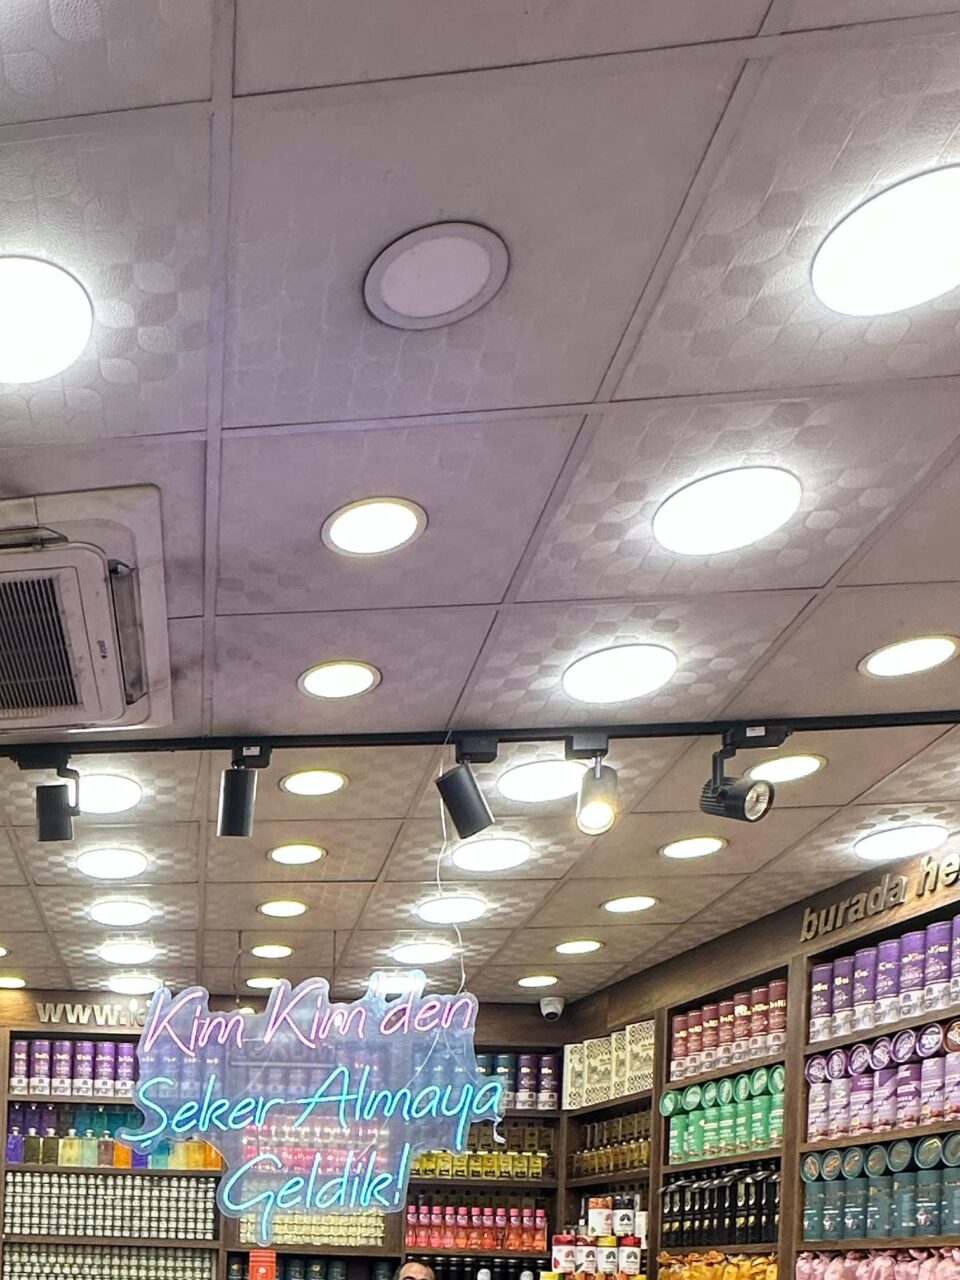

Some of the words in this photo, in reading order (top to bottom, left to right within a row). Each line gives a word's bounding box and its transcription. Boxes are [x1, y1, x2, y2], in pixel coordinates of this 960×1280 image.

[799, 874, 908, 943] burada
[143, 989, 244, 1057] Kim
[120, 1074, 285, 1148] Şeker
[293, 1065, 503, 1151] Almaya
[223, 1142, 412, 1242] Geldik!
